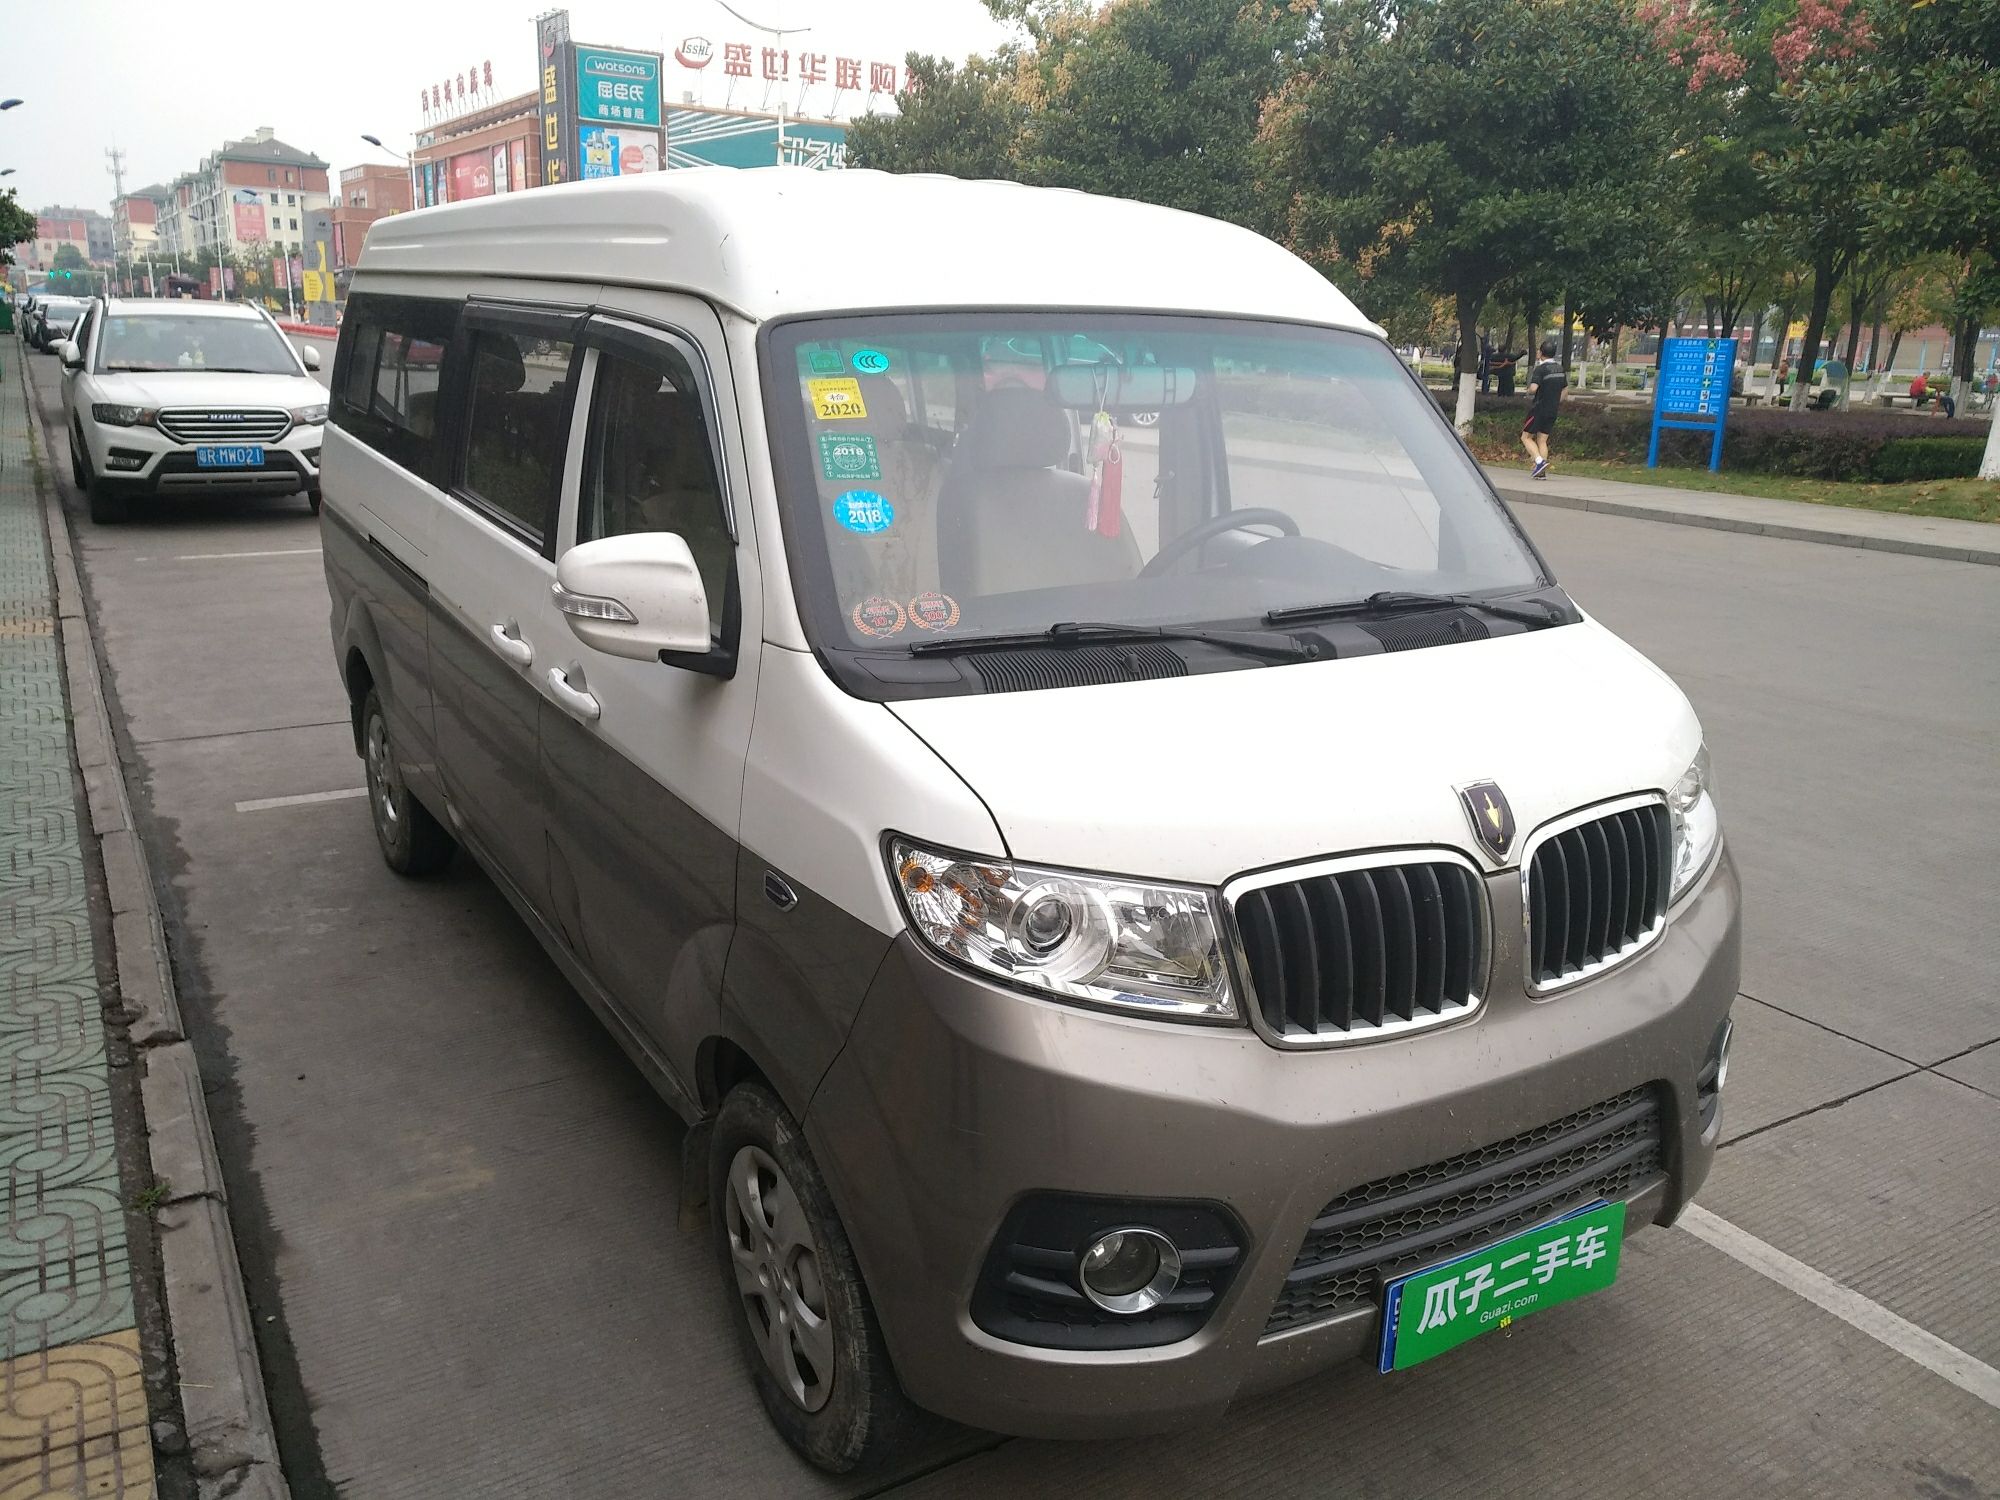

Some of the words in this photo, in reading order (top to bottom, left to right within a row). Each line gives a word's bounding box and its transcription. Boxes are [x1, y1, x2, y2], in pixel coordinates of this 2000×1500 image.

[595, 60, 646, 75] watsons
[598, 81, 645, 102] 屈臣氏
[598, 104, 645, 120] 商场首层
[820, 403, 861, 416] 2020
[834, 447, 864, 456] 2018
[848, 509, 882, 523] 2018
[1416, 1225, 1609, 1336] 瓜子二手车
[1479, 1292, 1539, 1325] Guazi.com
